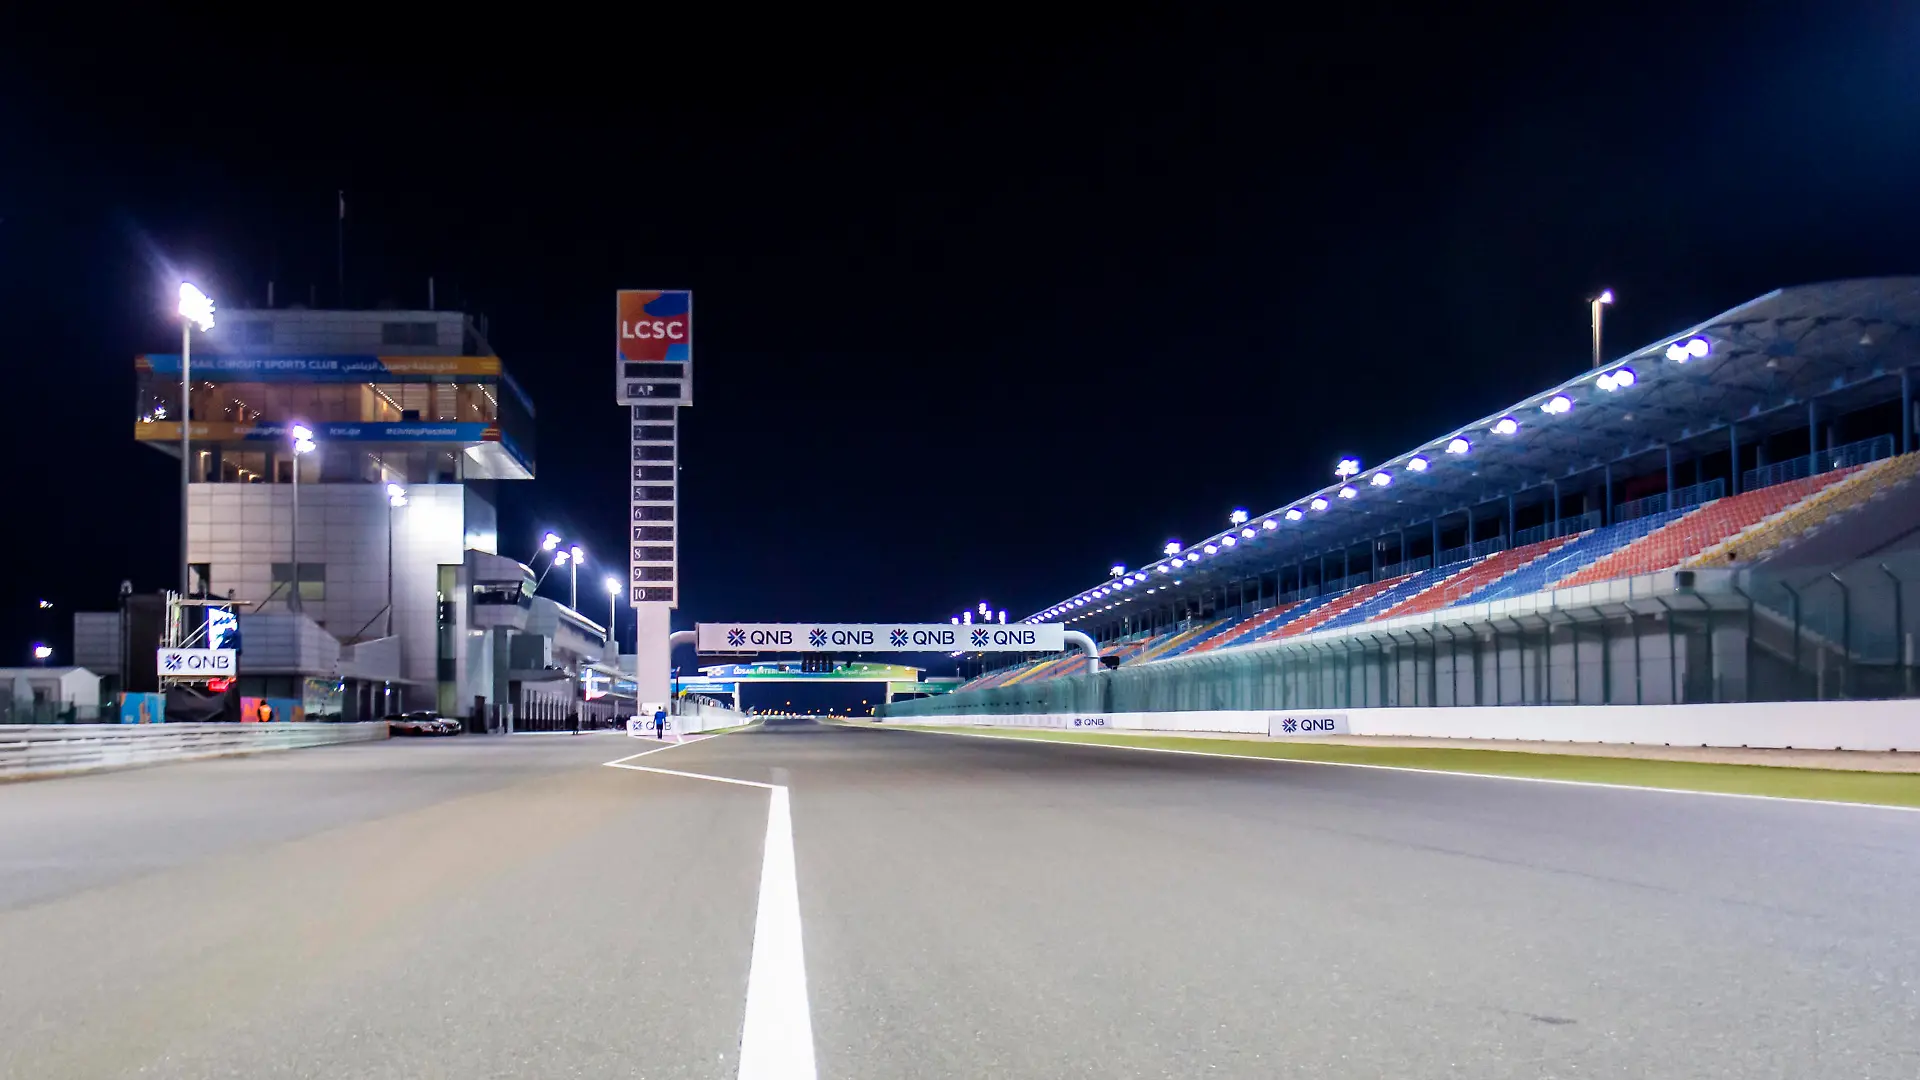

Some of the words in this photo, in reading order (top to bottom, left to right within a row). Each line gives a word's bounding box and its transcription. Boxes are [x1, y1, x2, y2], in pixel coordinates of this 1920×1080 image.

[622, 320, 684, 339] LCSC
[177, 360, 214, 369] LSAIL
[264, 360, 306, 369] SPORTS
[309, 360, 338, 369] CLUB
[628, 385, 654, 396] LAP
[635, 428, 642, 439] 2
[634, 448, 642, 459] 3
[635, 468, 642, 478] 4
[634, 488, 642, 499] 5
[634, 508, 642, 519] 6
[634, 528, 642, 539] 7
[634, 548, 641, 559] 8
[634, 568, 642, 579] 9
[634, 589, 646, 600] 10
[750, 630, 793, 645] QNB
[831, 630, 874, 645] QNB
[913, 630, 955, 645] QNB
[994, 630, 1036, 645] QNB
[645, 721, 672, 731] QB
[1083, 718, 1105, 726] QNB
[1301, 718, 1335, 731] QNB
